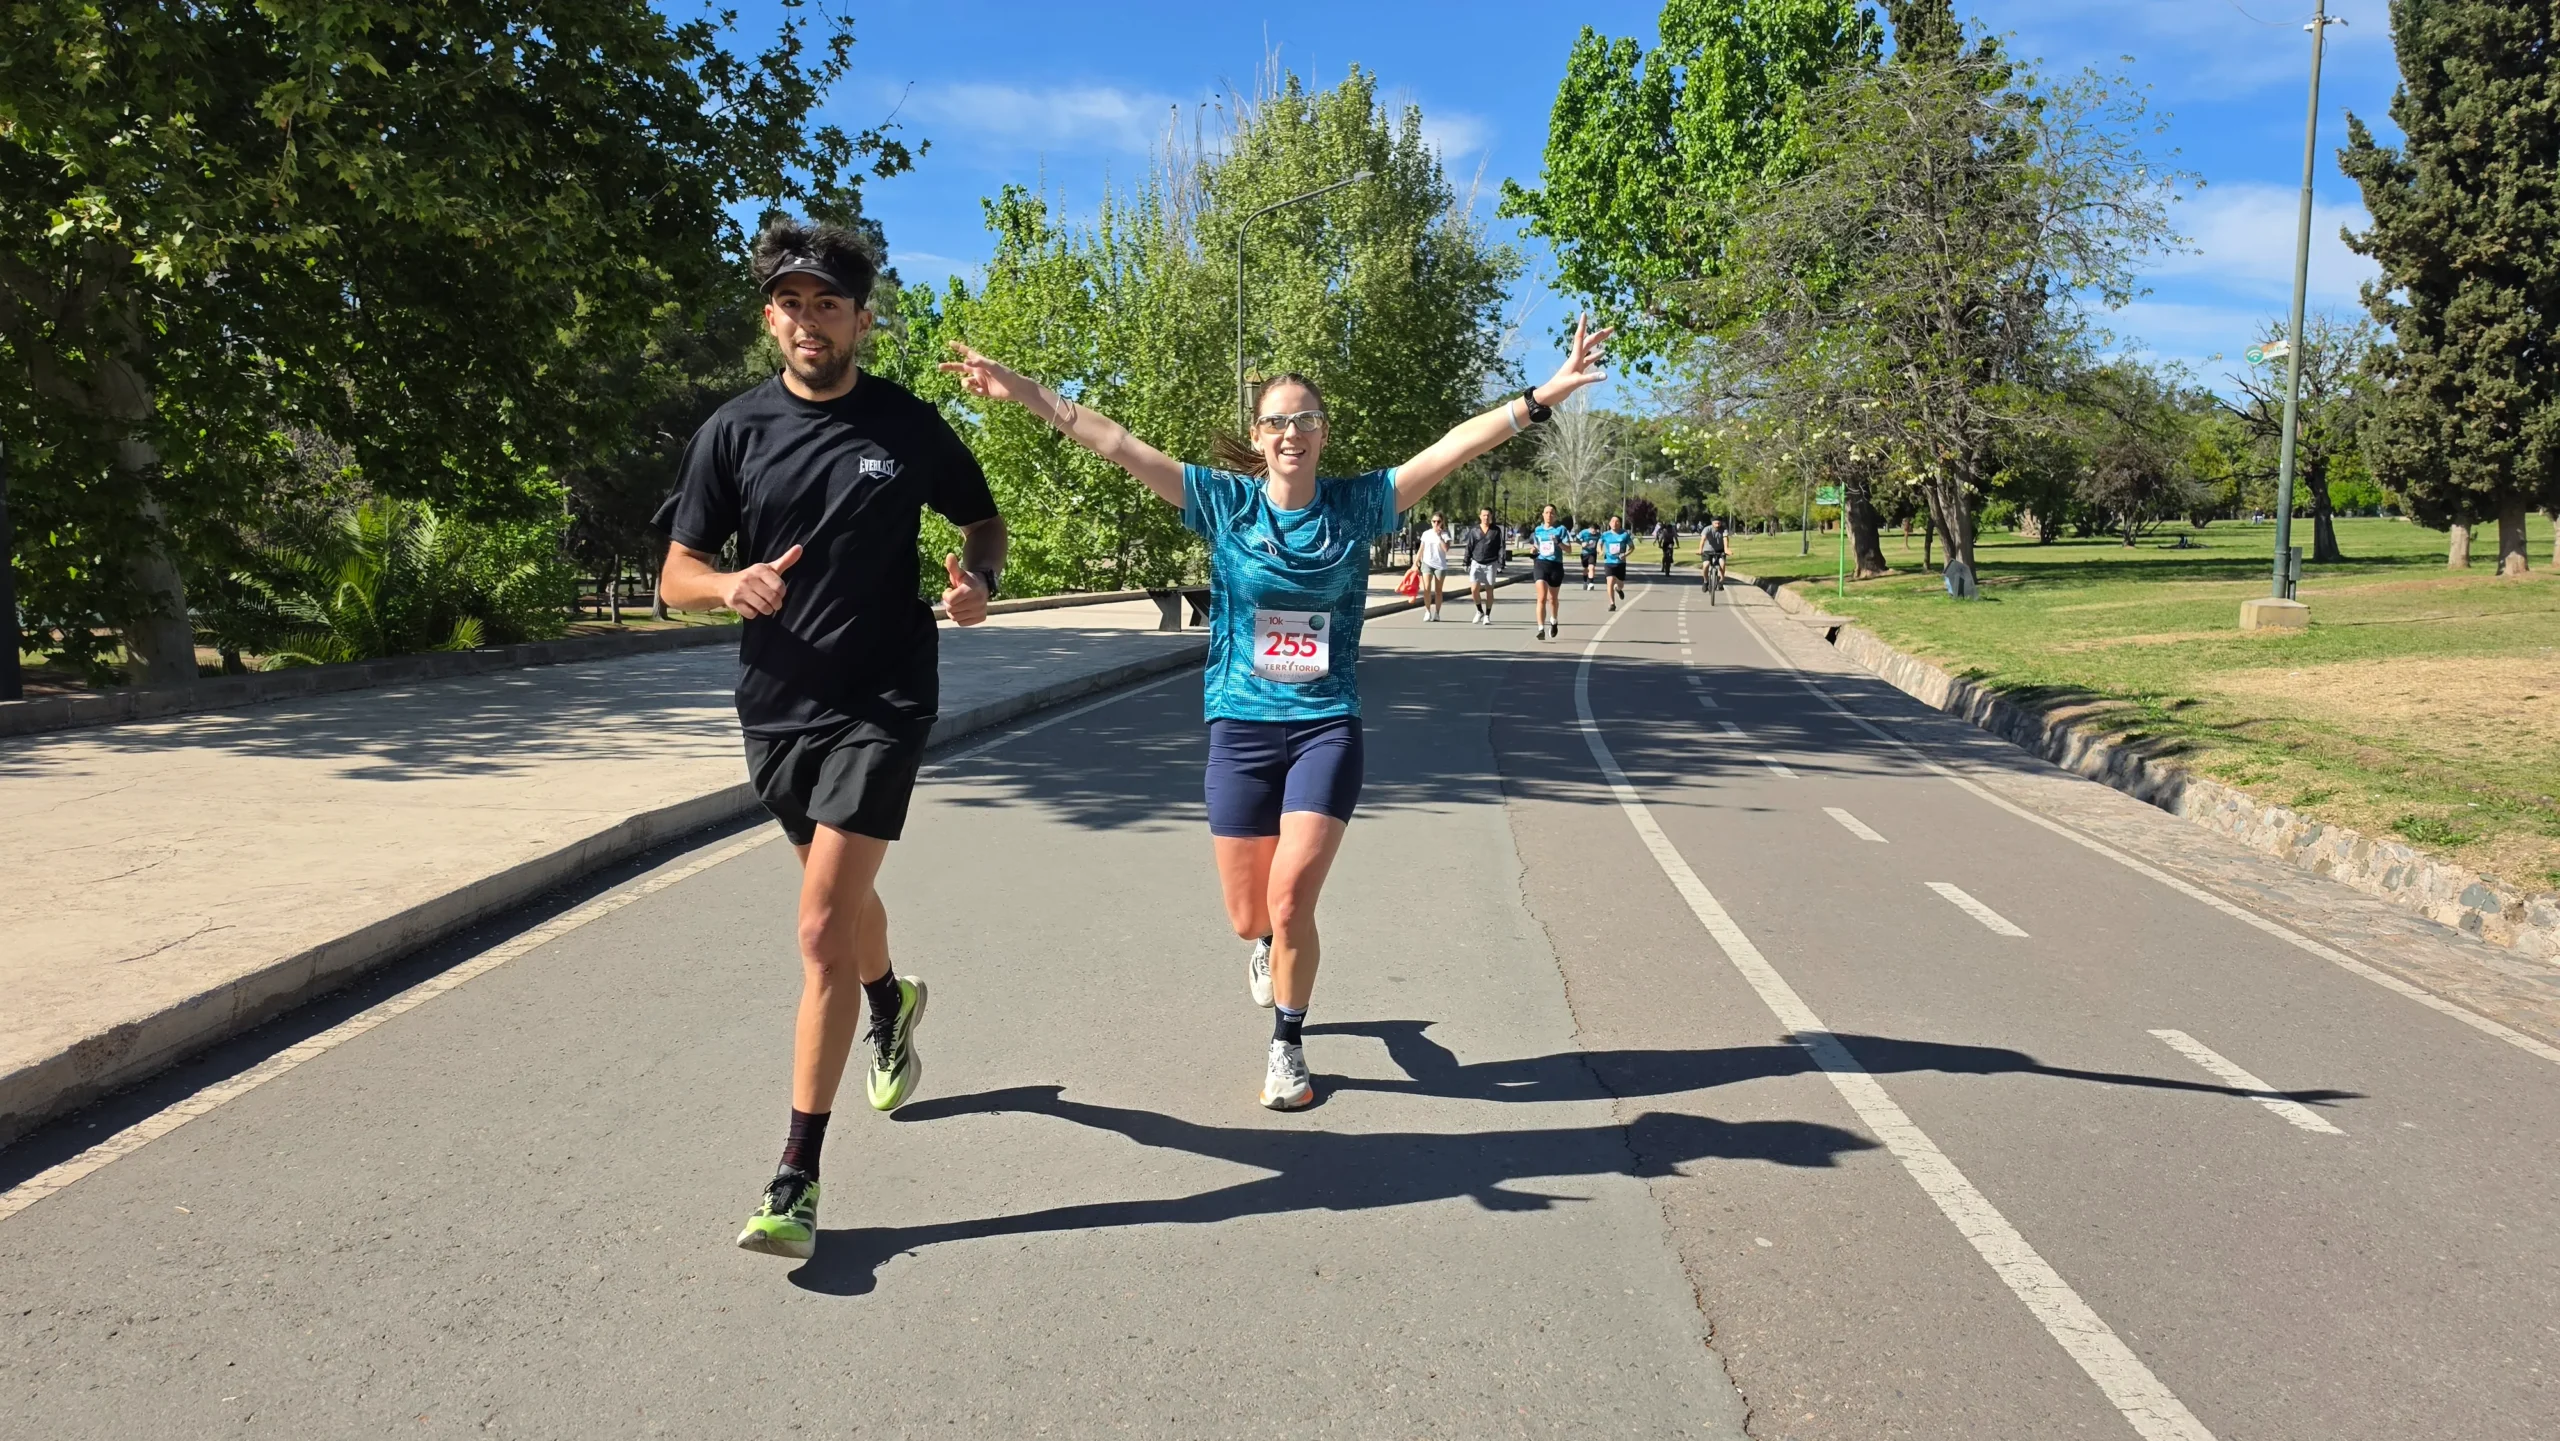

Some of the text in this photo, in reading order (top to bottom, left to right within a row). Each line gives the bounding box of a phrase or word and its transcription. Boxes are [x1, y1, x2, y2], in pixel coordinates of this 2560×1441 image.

[859, 456, 895, 477] EVERLAST
[1268, 616, 1283, 625] 10k
[1263, 631, 1317, 657] 255
